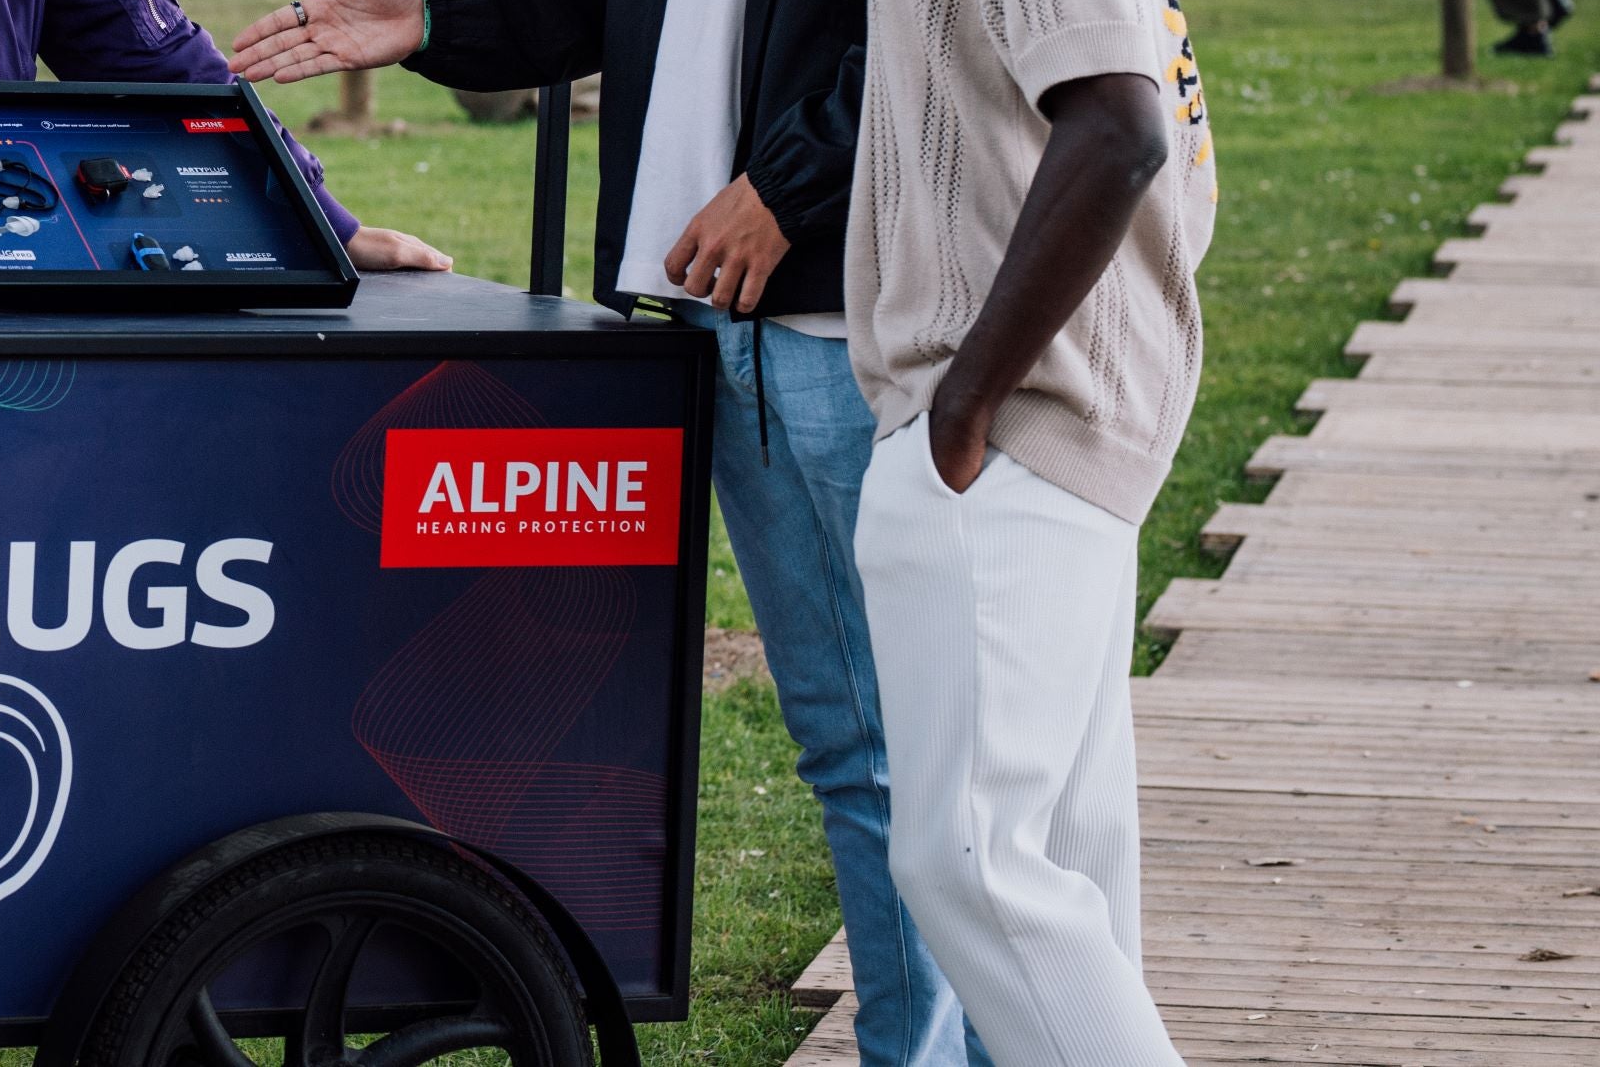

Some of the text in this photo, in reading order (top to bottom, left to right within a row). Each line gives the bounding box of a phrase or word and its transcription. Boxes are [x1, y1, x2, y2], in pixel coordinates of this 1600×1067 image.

[418, 461, 648, 513] ALPINE
[416, 520, 647, 534] HEARING PROTECTION
